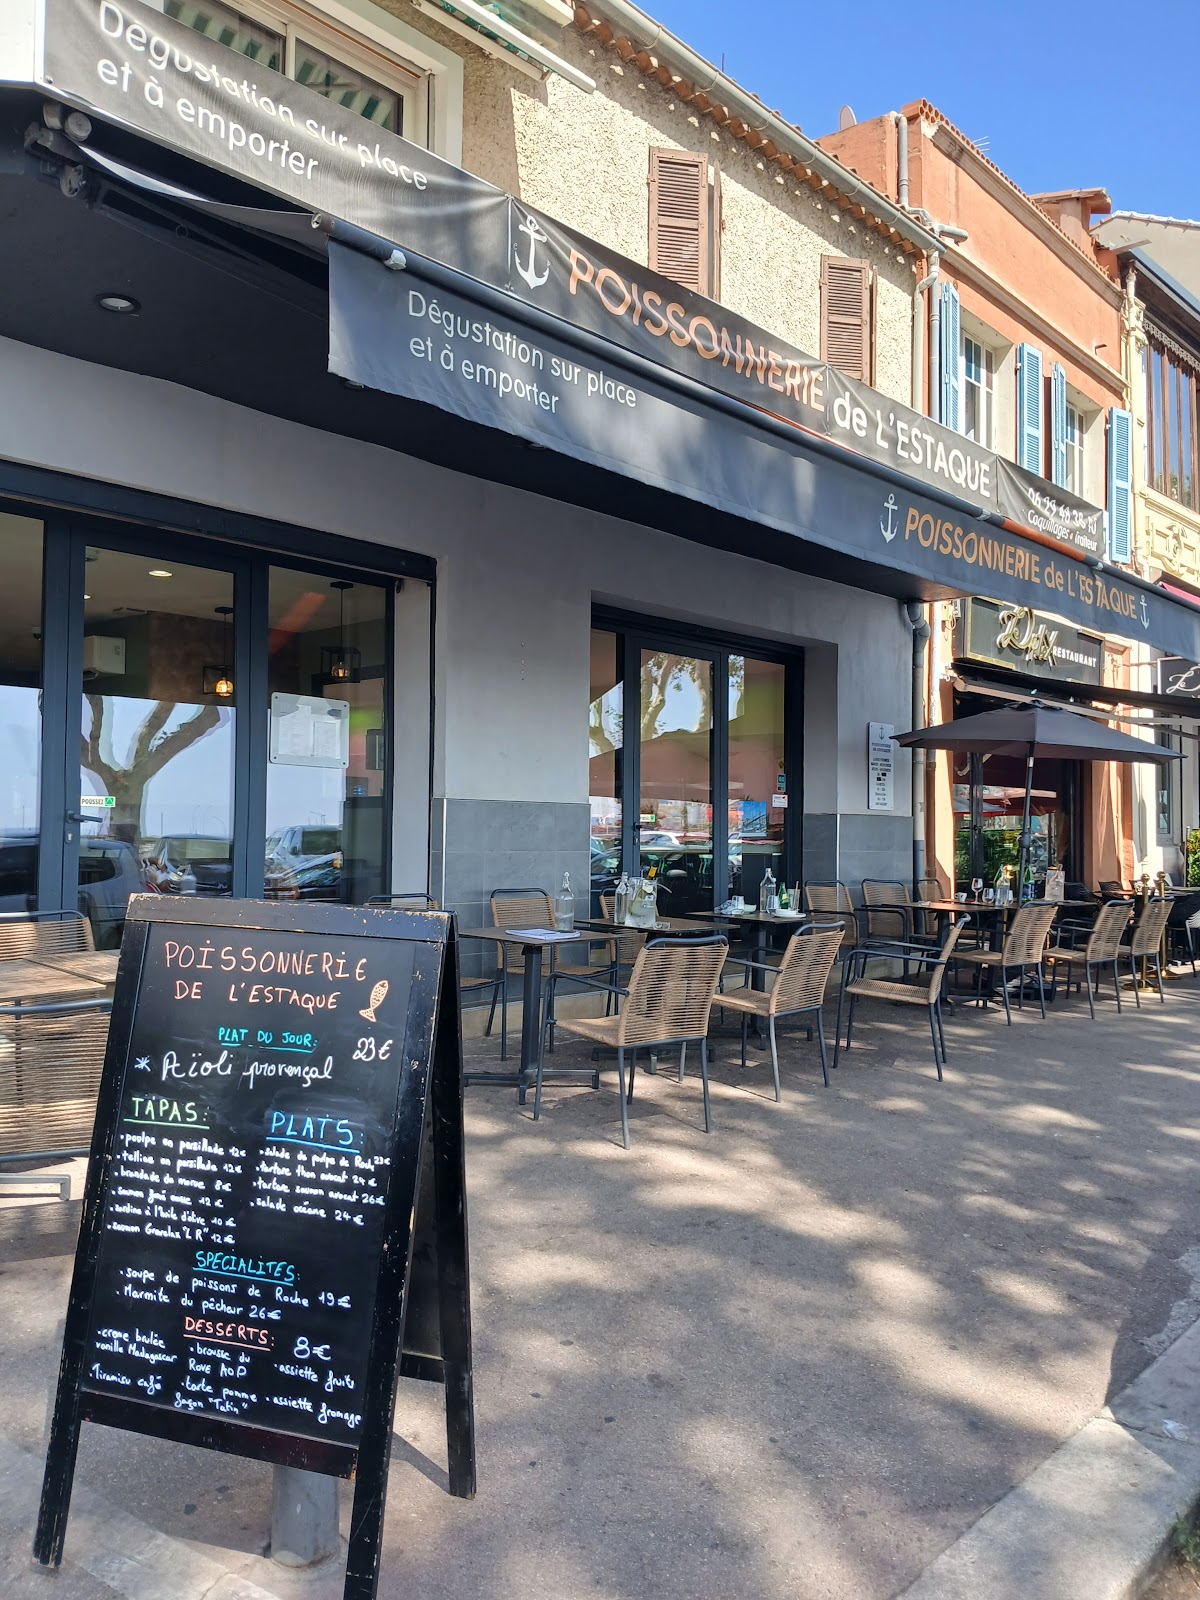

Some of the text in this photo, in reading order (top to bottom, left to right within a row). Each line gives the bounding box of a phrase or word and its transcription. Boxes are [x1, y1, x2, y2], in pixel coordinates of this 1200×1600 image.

[97, 58, 319, 180] et à emporter
[305, 119, 349, 151] sur
[357, 143, 428, 190] place
[408, 290, 637, 408] Dégustation sur place
[409, 336, 560, 414] et à emporter
[568, 248, 991, 498] POISSONNERIE de L'ESTAQUE
[1027, 509, 1070, 540] Coquillages
[904, 507, 1041, 584] POISSONNERIE
[1044, 561, 1064, 592] de
[1074, 531, 1098, 552] Traiteur
[1053, 646, 1097, 668] RESTAURANT
[165, 939, 368, 982] POISSONNERIE
[174, 980, 342, 1015] DE L'ESTAQUE
[218, 1026, 249, 1042] PLAT
[257, 1030, 273, 1044] DU
[352, 1036, 393, 1062] 23€
[160, 1051, 234, 1082] Aïoli
[125, 1131, 156, 1147] poulpe
[162, 1138, 173, 1148] en
[160, 1157, 171, 1166] en
[296, 1150, 308, 1161] de
[339, 1156, 350, 1167] de
[296, 1164, 316, 1179] thon
[120, 1165, 160, 1183] brandade
[163, 1173, 174, 1184] de
[124, 1283, 282, 1320] Marmite du pêcheur 26€
[126, 1267, 155, 1284] soupe
[165, 1270, 180, 1284] de
[192, 1277, 238, 1294] poissons
[248, 1284, 261, 1297] de
[275, 1286, 309, 1308] Roche
[95, 1340, 178, 1365] vanille Madagascar
[196, 1342, 251, 1364] brousse du
[293, 1336, 332, 1361] 8€
[91, 1362, 162, 1395] Tiramisu café
[185, 1375, 258, 1402] tarte pomme
[279, 1364, 355, 1393] assiette fruits
[273, 1396, 314, 1413] assiette
